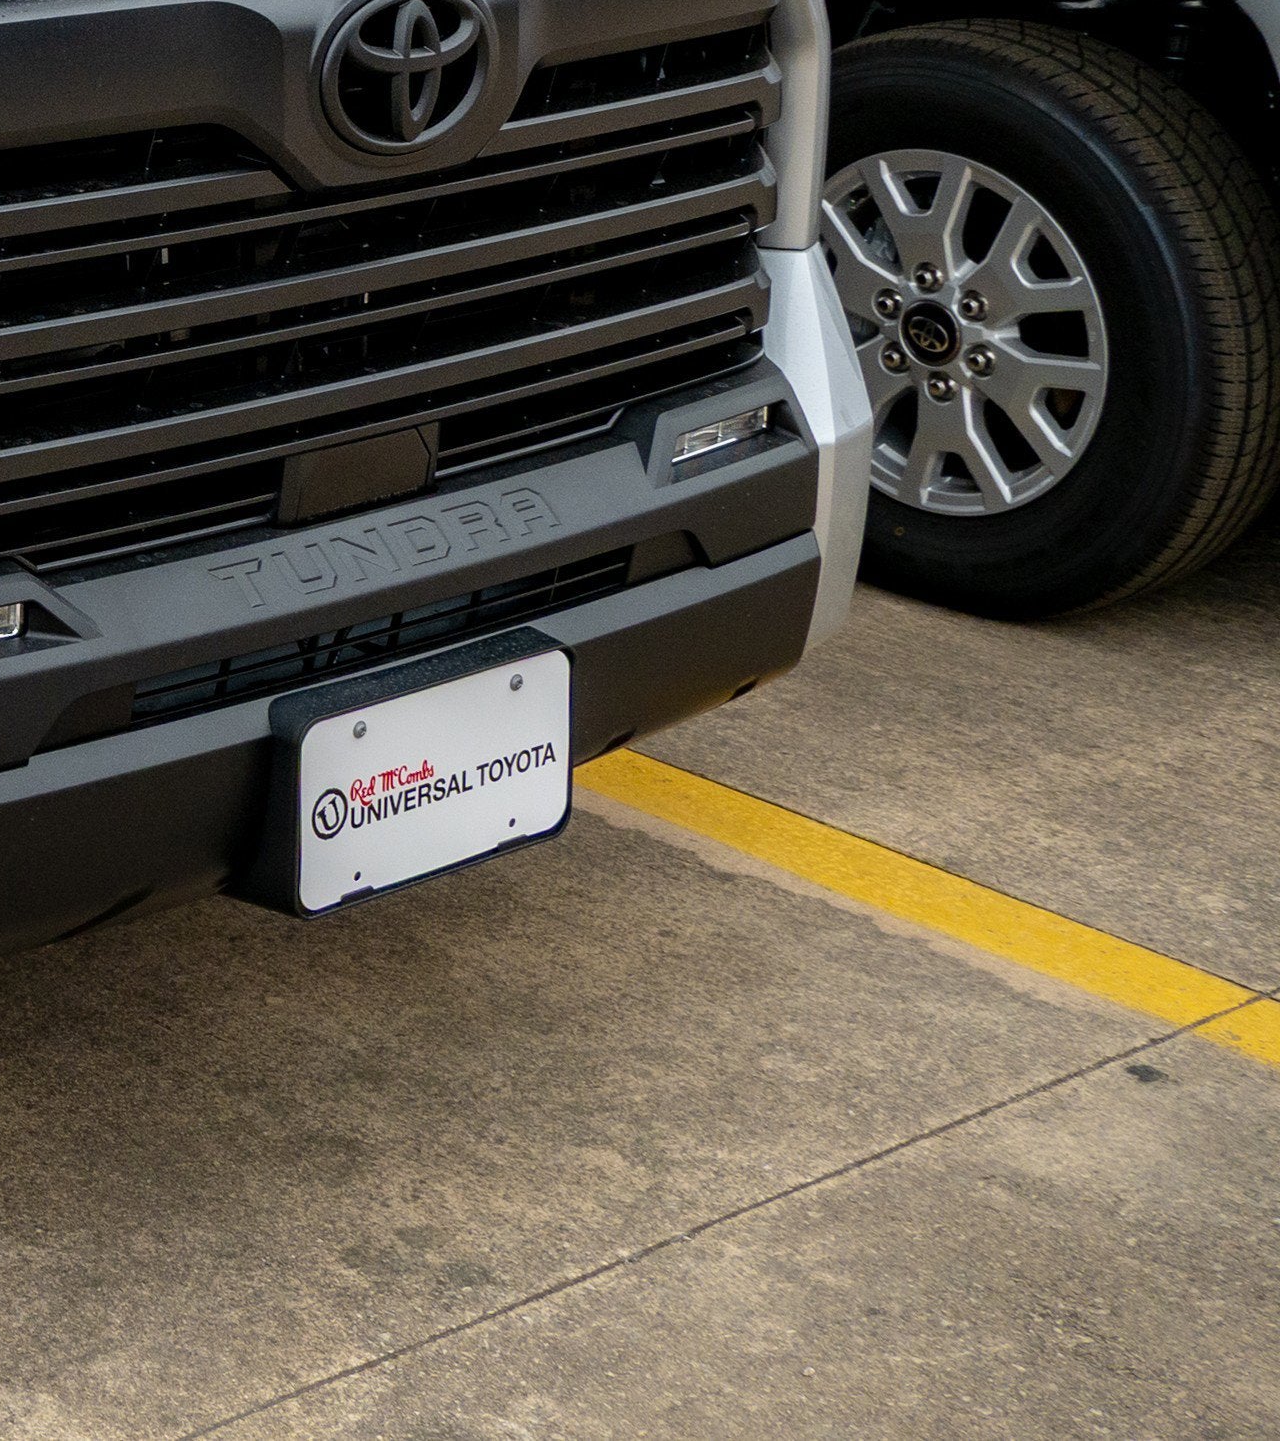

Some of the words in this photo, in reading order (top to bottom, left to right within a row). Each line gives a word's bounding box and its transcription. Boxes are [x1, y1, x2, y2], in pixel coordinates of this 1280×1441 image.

[208, 486, 564, 609] TUNDRA
[350, 776, 376, 807] Red
[378, 759, 435, 792] McCombs
[350, 770, 473, 829] UNIVERSAL
[476, 742, 557, 787] TOYOTA
